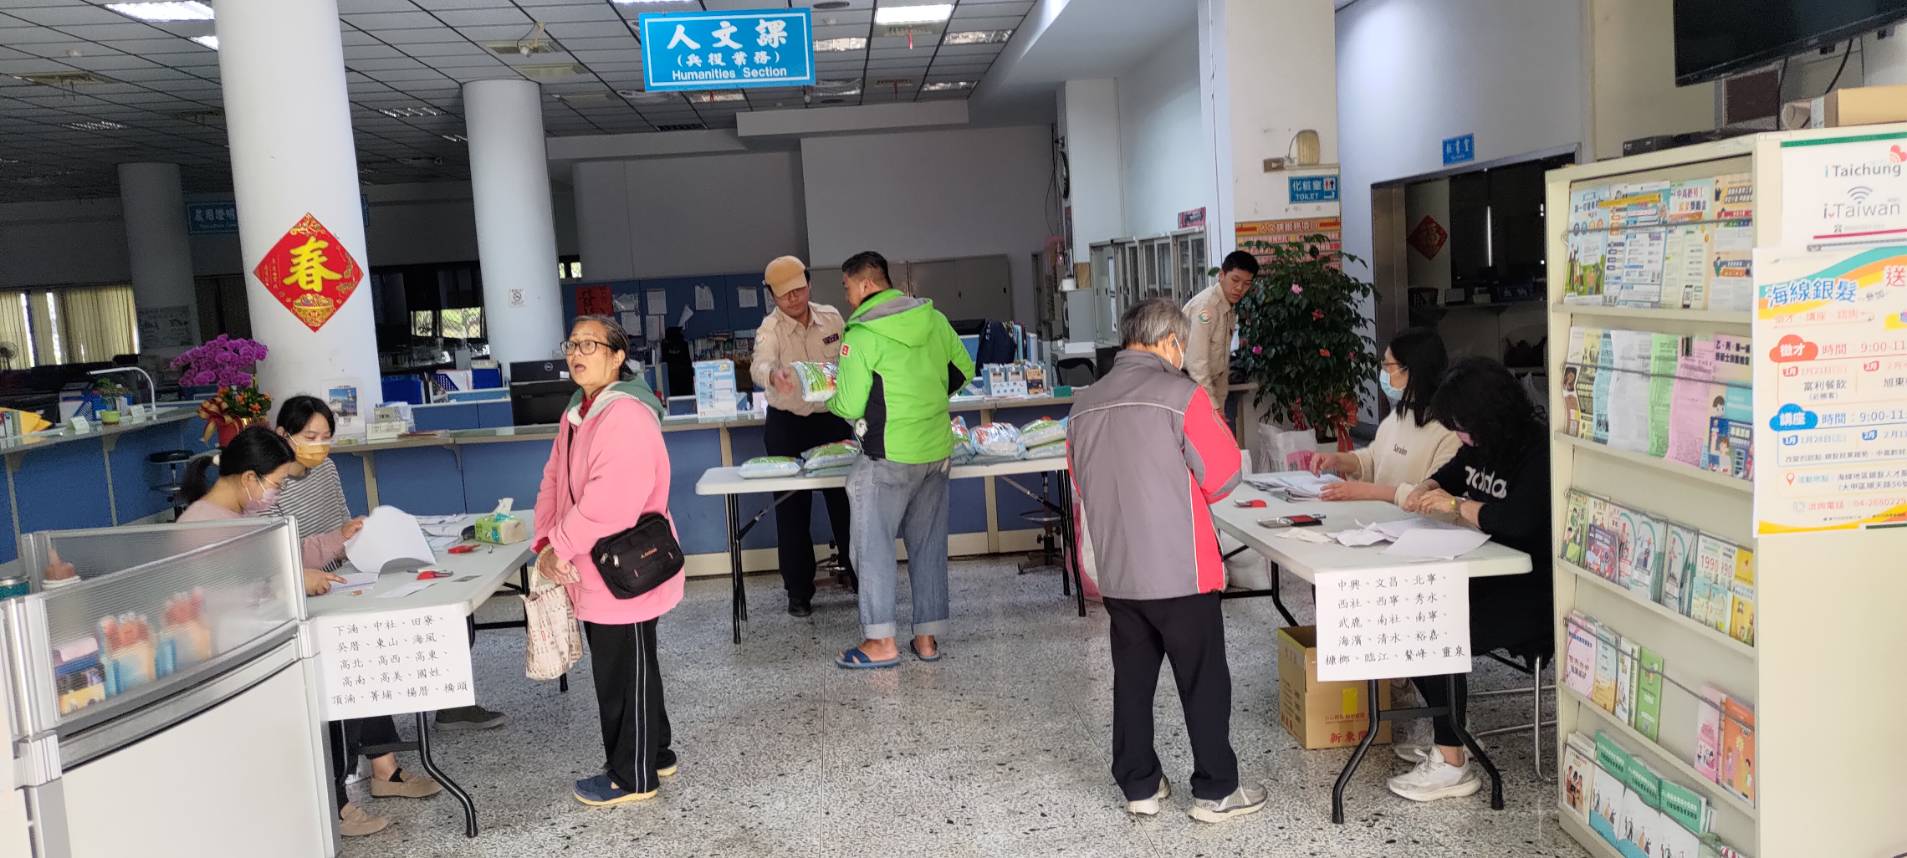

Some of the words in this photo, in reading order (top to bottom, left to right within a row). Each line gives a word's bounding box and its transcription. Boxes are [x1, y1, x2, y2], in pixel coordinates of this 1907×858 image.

[667, 18, 788, 50] 人文課
[672, 70, 736, 81] Humanities
[743, 66, 787, 78] Section
[1833, 162, 1901, 177] Taichung
[282, 236, 342, 292] 春
[1885, 266, 1906, 288] 送
[1769, 279, 1857, 308] 海線銀髮
